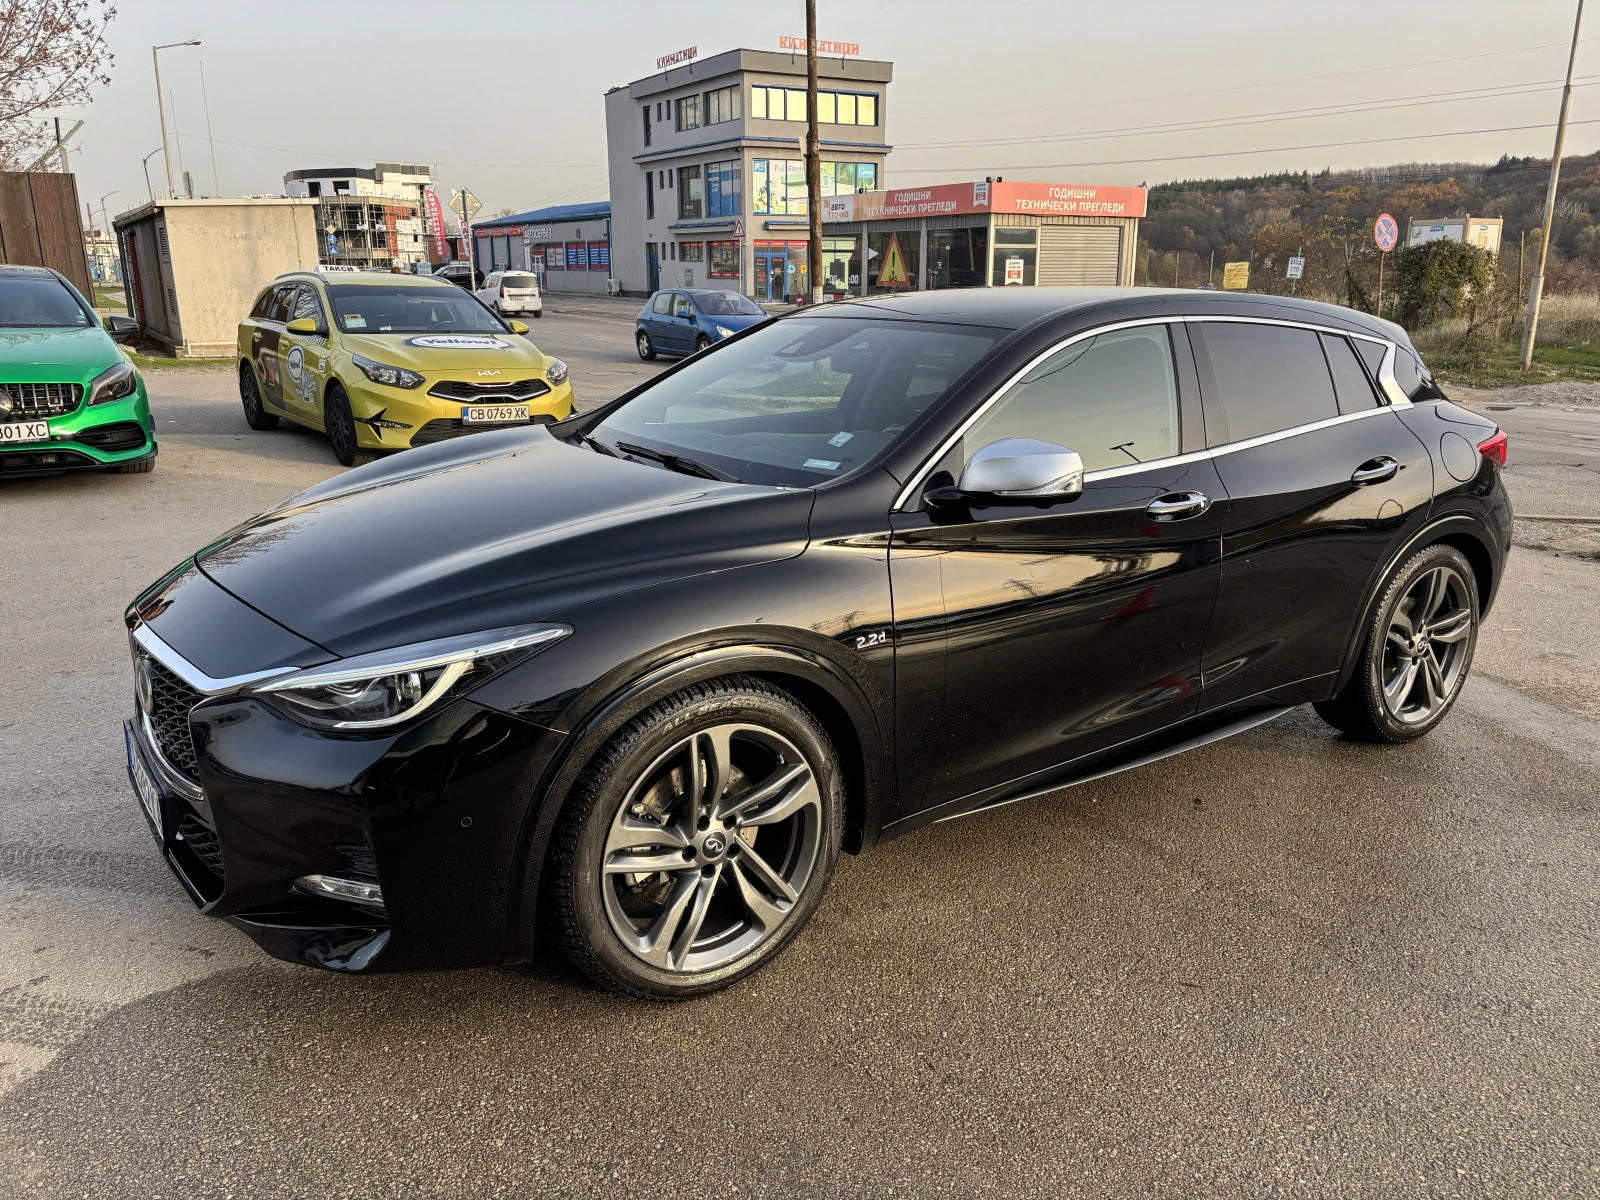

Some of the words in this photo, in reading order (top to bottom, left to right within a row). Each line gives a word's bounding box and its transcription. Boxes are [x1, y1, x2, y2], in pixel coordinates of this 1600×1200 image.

[780, 36, 859, 56] КЛИАТИЦИ
[656, 46, 698, 69] КЛИМАТИЦИ
[894, 190, 931, 203] ГОДИШНИ
[1049, 187, 1096, 199] ГОДИШНИ
[830, 202, 845, 210] авто
[919, 201, 957, 213] ПРЕГЛЕДИ
[1016, 199, 1077, 212] ТЕХНИЧЕСКИ
[1079, 201, 1125, 214] ПРЕГЛЕДИ
[831, 210, 848, 219] точка
[470, 409, 485, 420] CB
[487, 407, 513, 420] 0769
[514, 407, 527, 419] XK
[25, 424, 46, 438] XC
[856, 631, 886, 650] 2.2d
[661, 712, 694, 735] ALL
